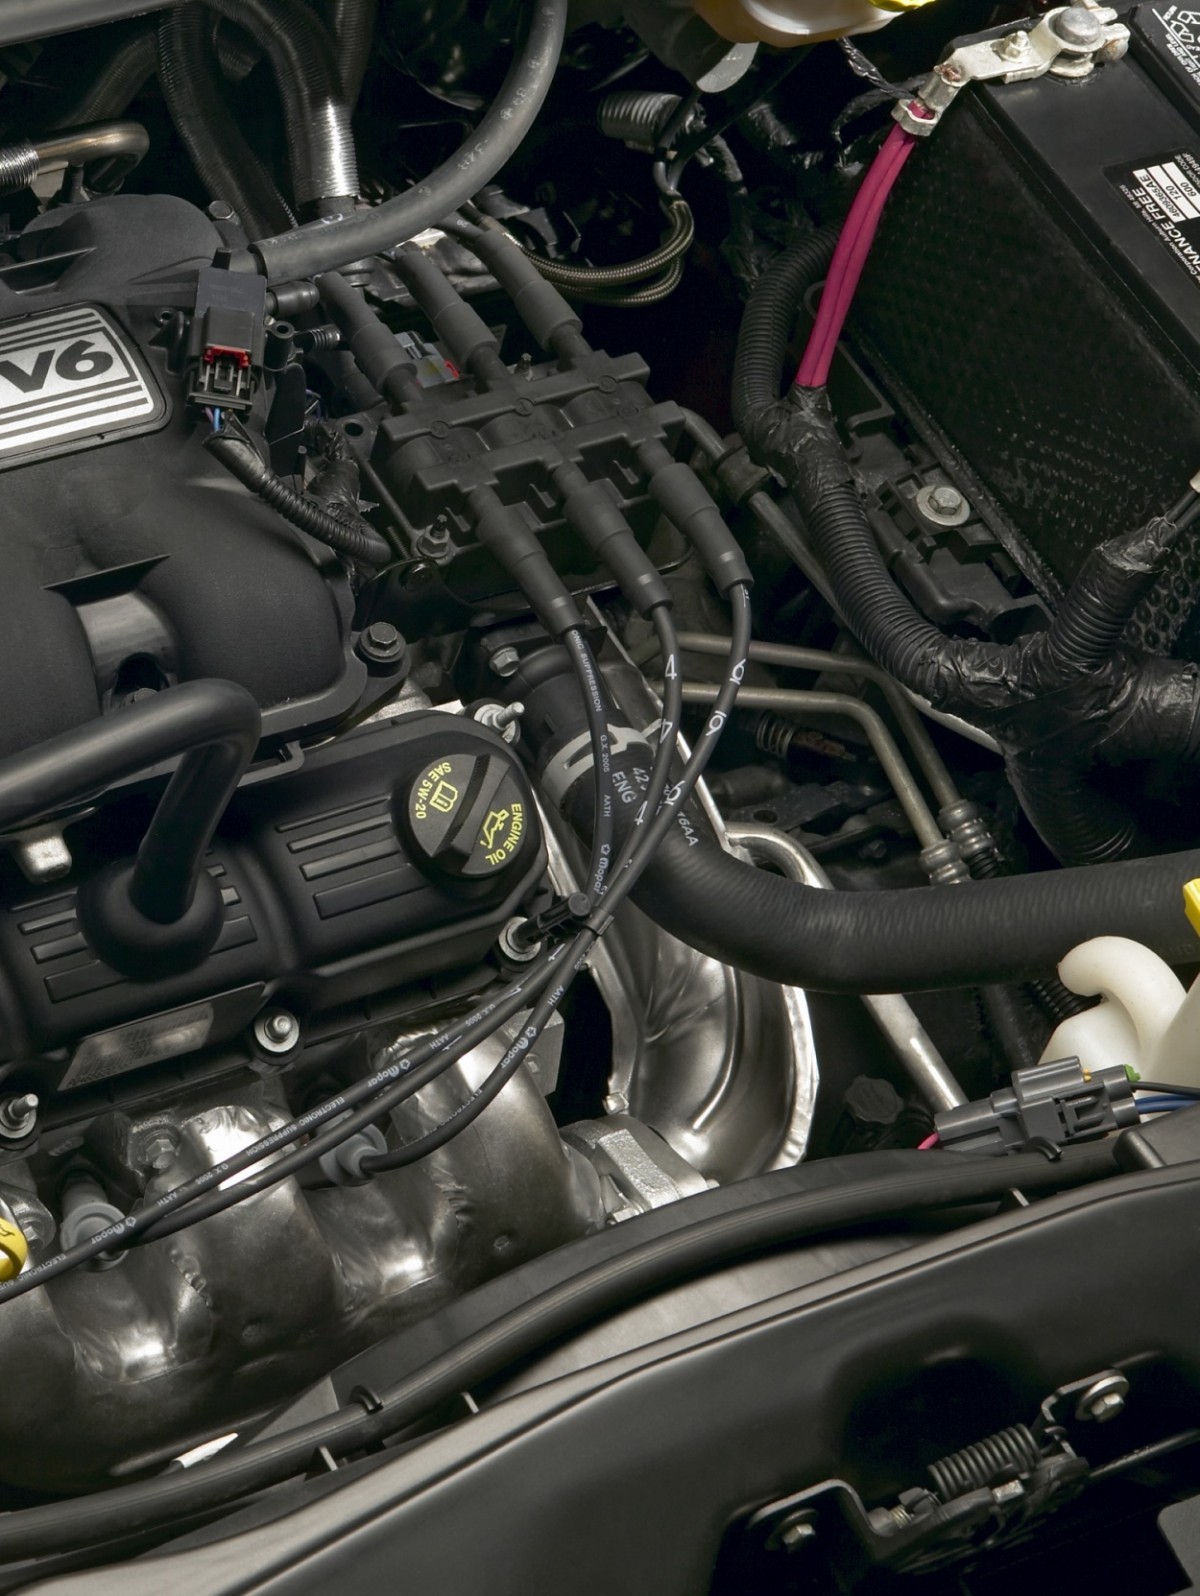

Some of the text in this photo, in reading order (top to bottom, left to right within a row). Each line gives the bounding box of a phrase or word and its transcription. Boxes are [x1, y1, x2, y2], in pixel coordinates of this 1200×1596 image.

[1132, 187, 1166, 220] FREE
[1166, 186, 1182, 200] 120
[1180, 182, 1197, 198] 600
[1169, 242, 1198, 276] Corporation
[580, 653, 602, 712] SUPPRESSION
[664, 653, 676, 680] 4
[415, 762, 452, 819] SAE 5W-20
[611, 770, 637, 804] ENG
[485, 803, 523, 866] ENGINE OIL
[594, 857, 610, 894] Mopar
[500, 1037, 530, 1070] Mopar
[367, 1065, 400, 1088] Mopar
[246, 1096, 345, 1156] ELECTRONIC SUPPRESSION
[90, 1223, 126, 1244] Mopar
[16, 1253, 66, 1282] ELECTRONIC
